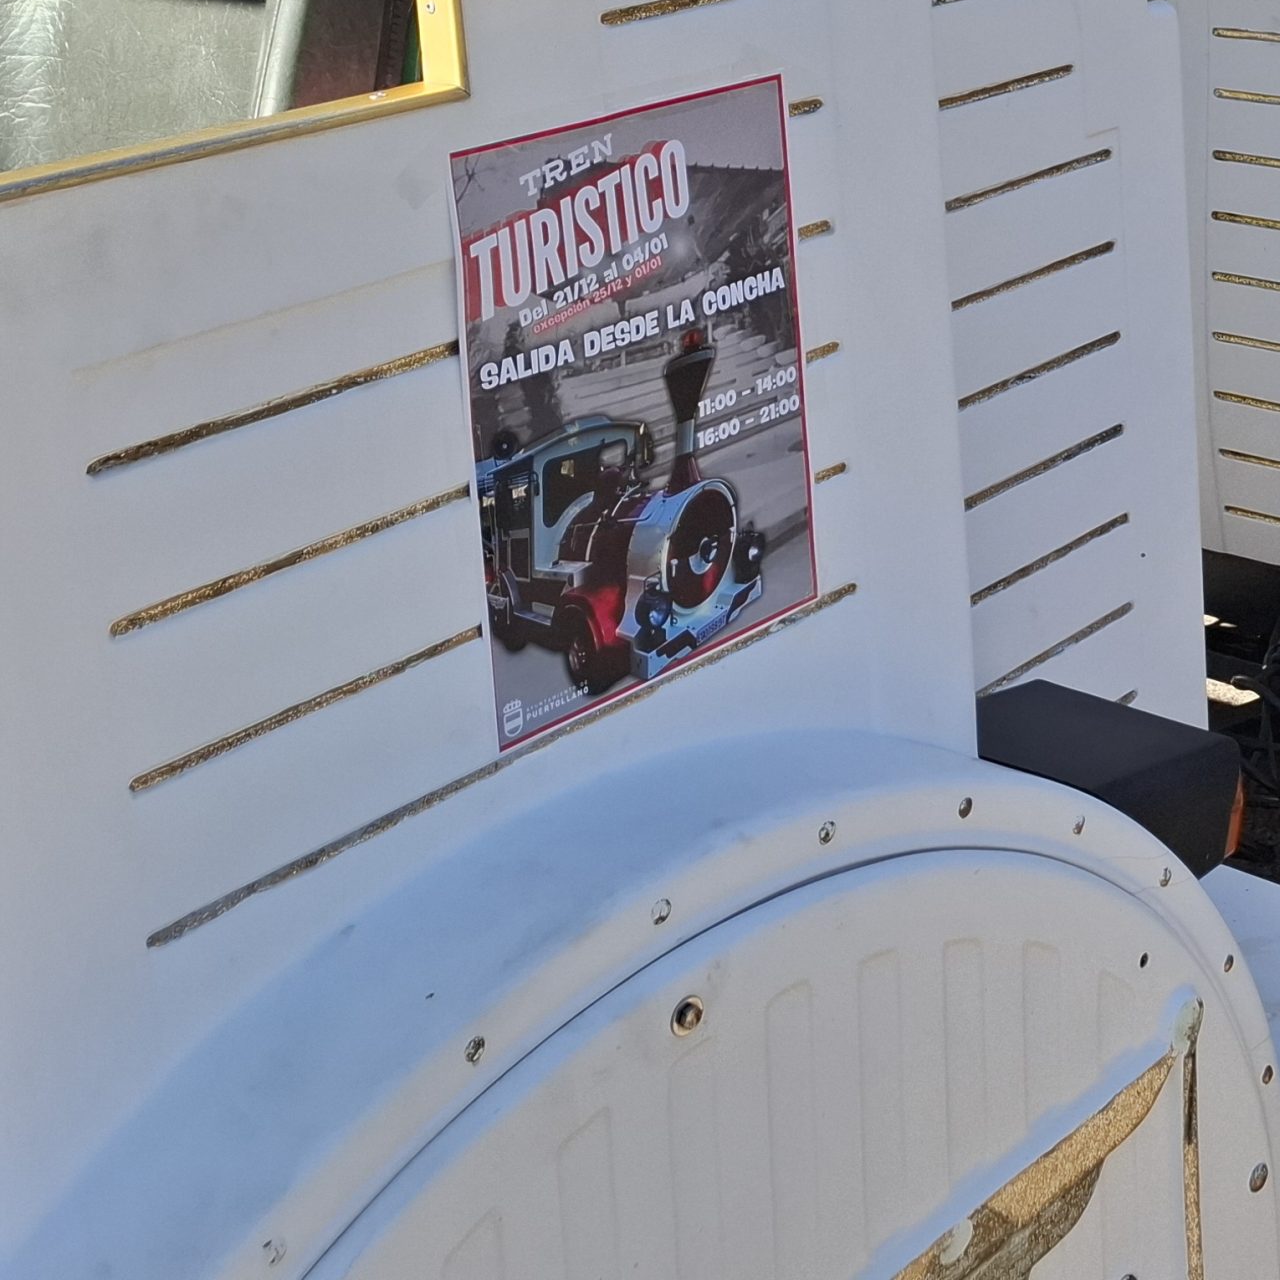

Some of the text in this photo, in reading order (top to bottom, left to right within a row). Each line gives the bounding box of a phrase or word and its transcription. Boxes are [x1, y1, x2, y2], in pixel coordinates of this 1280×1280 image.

[519, 132, 612, 197] TREN
[469, 138, 690, 323] TURISTICO
[519, 232, 669, 328] Del 21/12 al 04/01
[592, 281, 623, 304] 25/12
[626, 276, 633, 288] y
[635, 255, 662, 278] 01/01
[479, 267, 786, 390] SALIDA DESDE LA CONCHA
[697, 418, 740, 449] 16:00
[759, 394, 800, 424] 21:00
[698, 389, 737, 418] 11:00
[756, 366, 797, 395] 14:00
[526, 686, 589, 721] PUERTOLLANO
